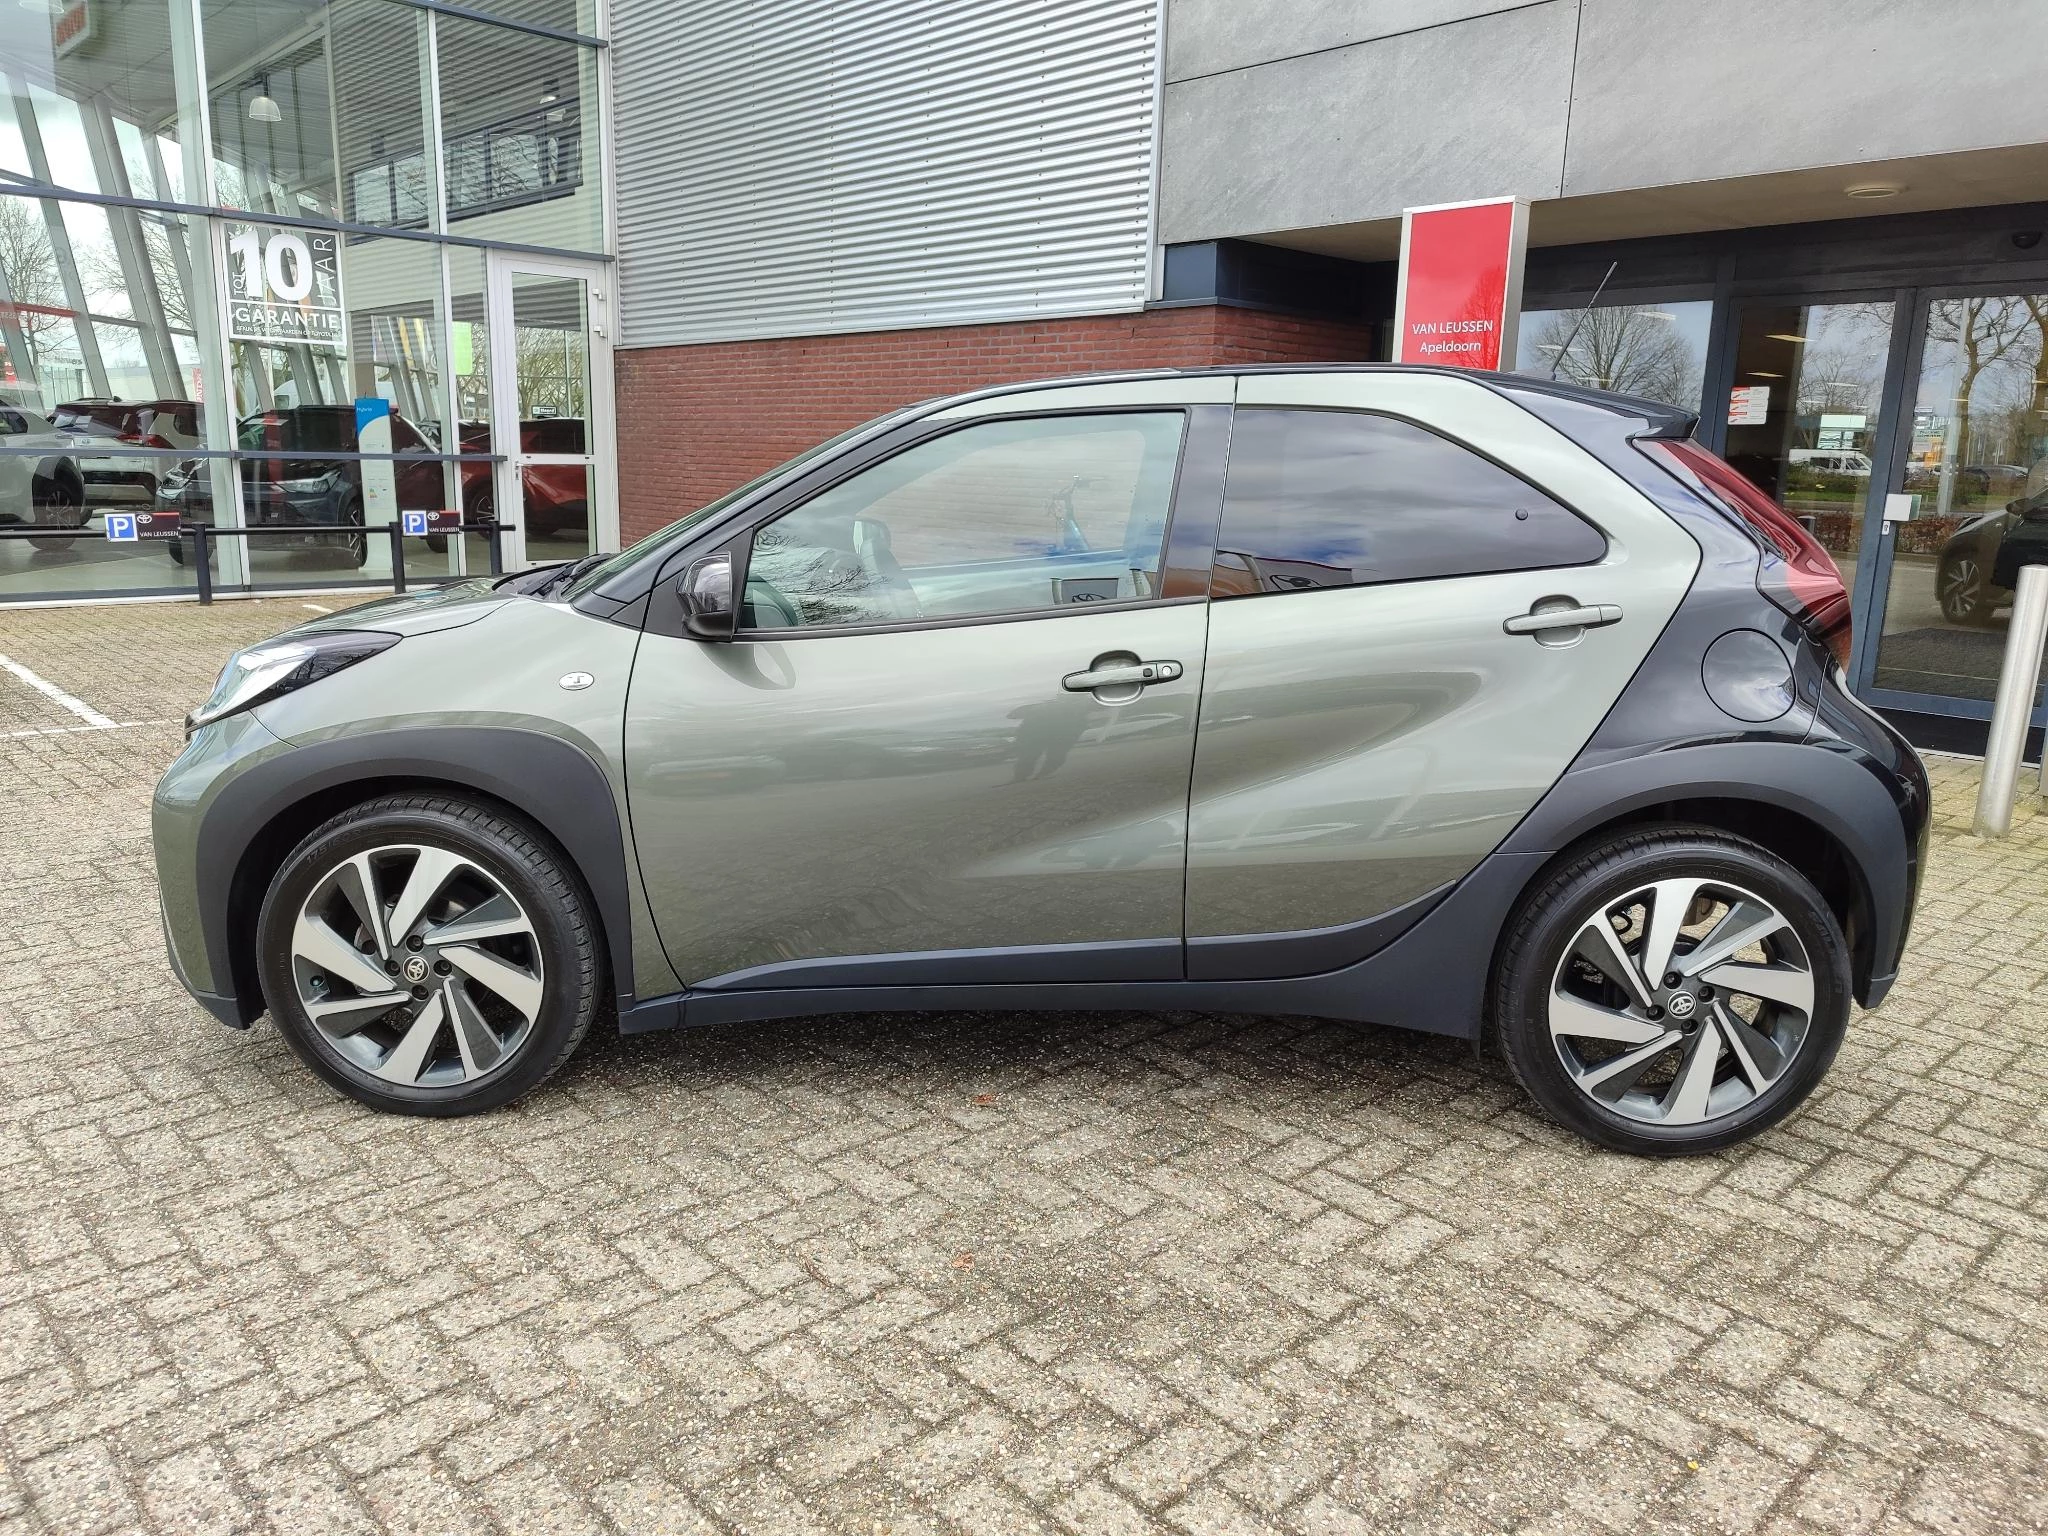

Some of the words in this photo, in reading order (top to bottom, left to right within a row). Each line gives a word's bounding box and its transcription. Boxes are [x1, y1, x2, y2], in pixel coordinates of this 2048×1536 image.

[229, 229, 313, 301] 10
[313, 238, 337, 306] JAAR
[235, 307, 338, 329] GARANTIE
[1412, 322, 1437, 335] VAN
[1439, 320, 1493, 334] LEUSSEN
[1419, 340, 1481, 355] Apeldoorn
[112, 517, 129, 538] P
[408, 514, 422, 532] P
